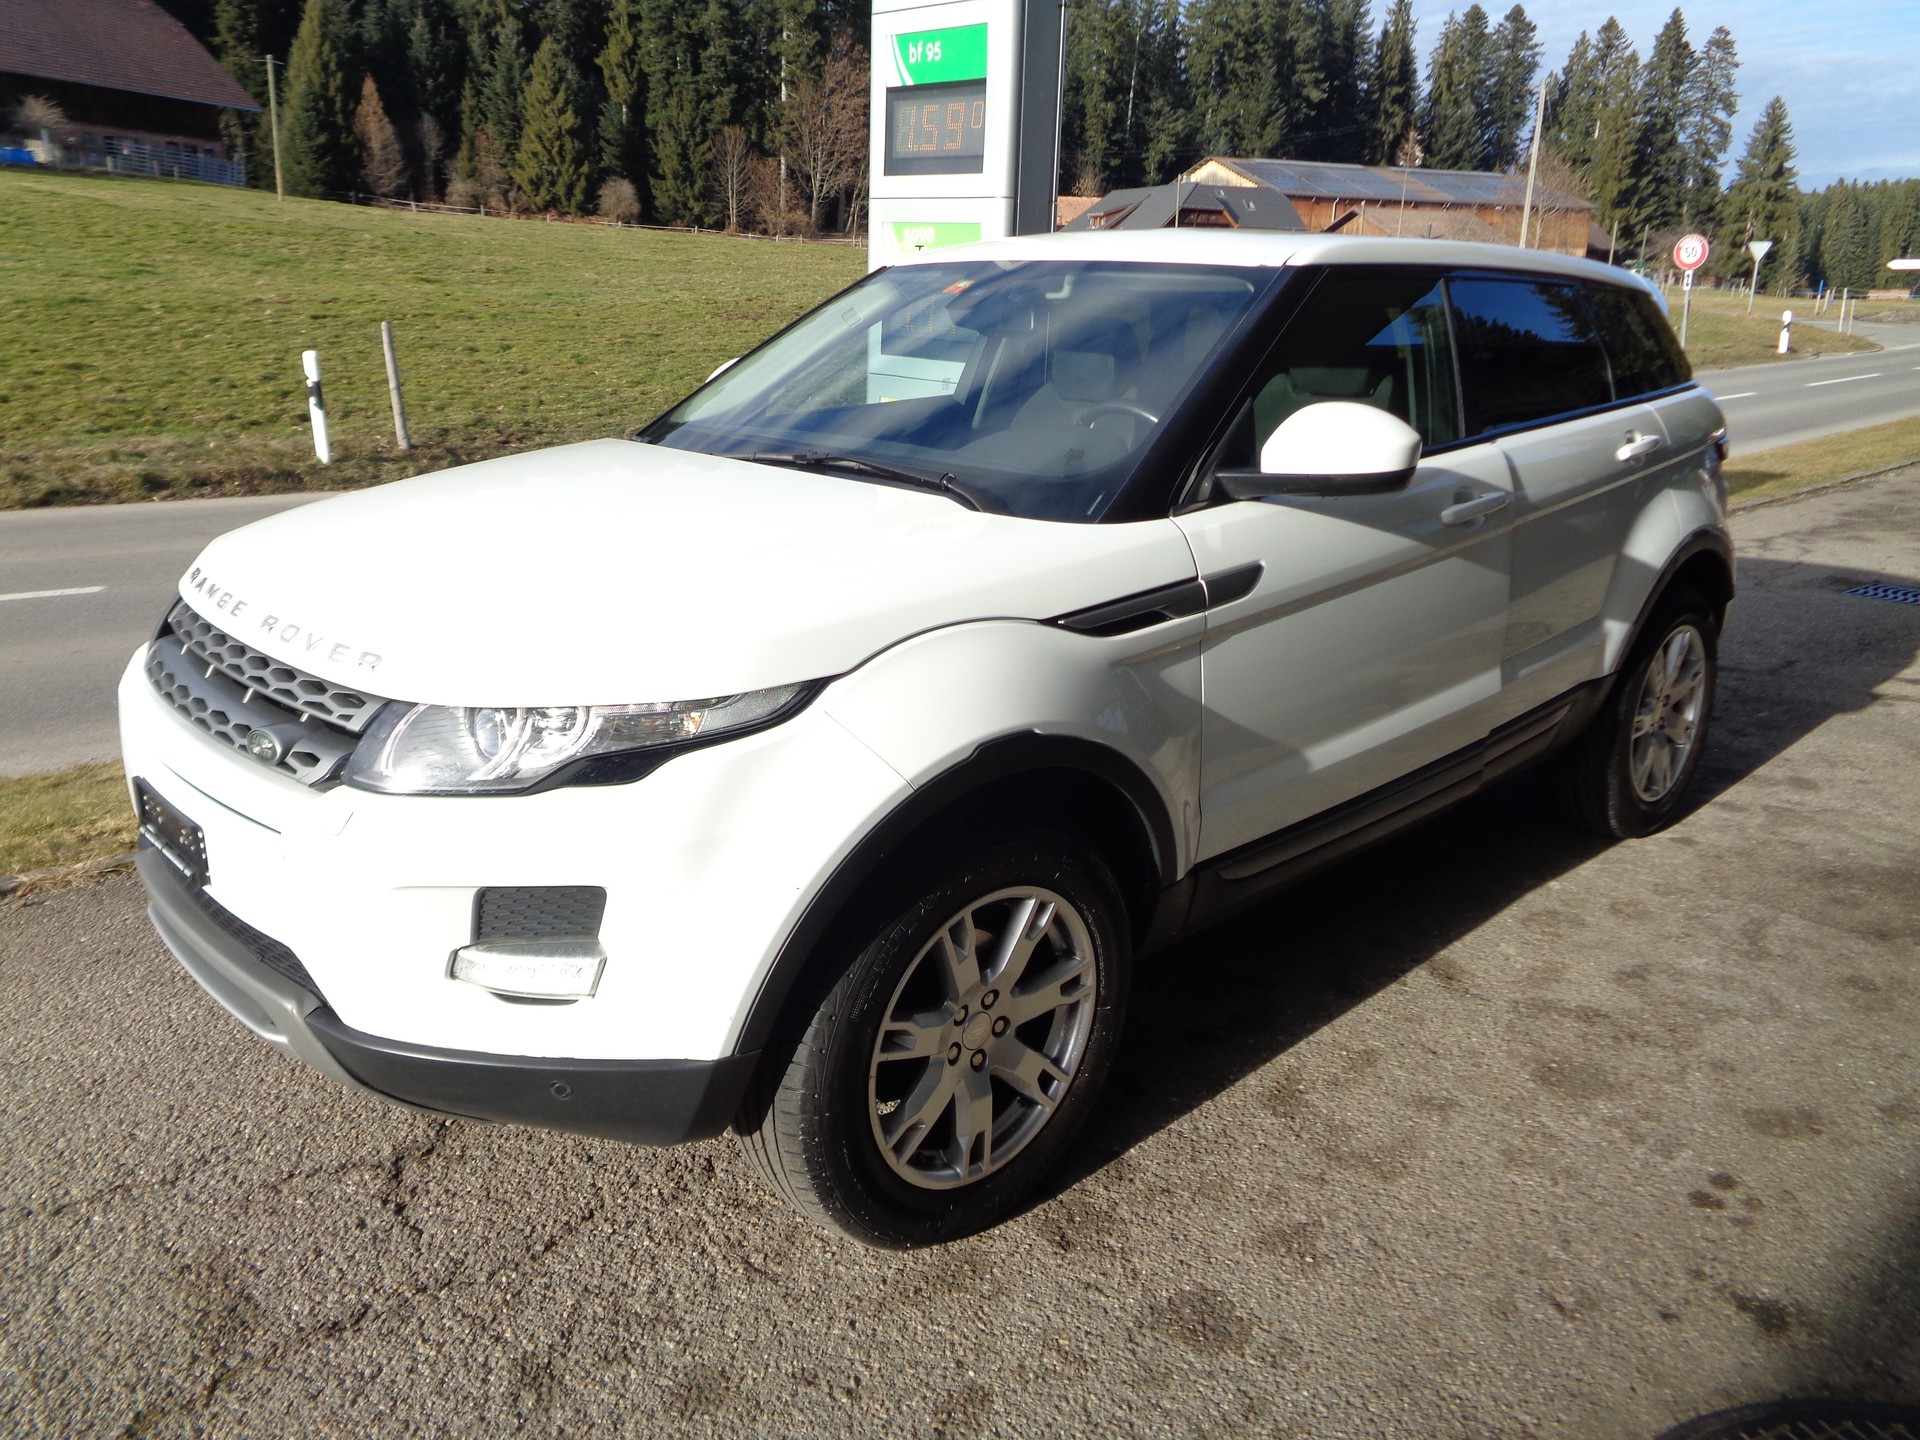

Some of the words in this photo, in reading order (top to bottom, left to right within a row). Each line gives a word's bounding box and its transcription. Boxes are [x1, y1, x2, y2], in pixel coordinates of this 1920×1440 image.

[908, 39, 924, 63] bf
[926, 40, 943, 62] 95
[1685, 246, 1698, 258] 50
[190, 567, 247, 617] RANGE
[259, 614, 382, 671] ROVER
